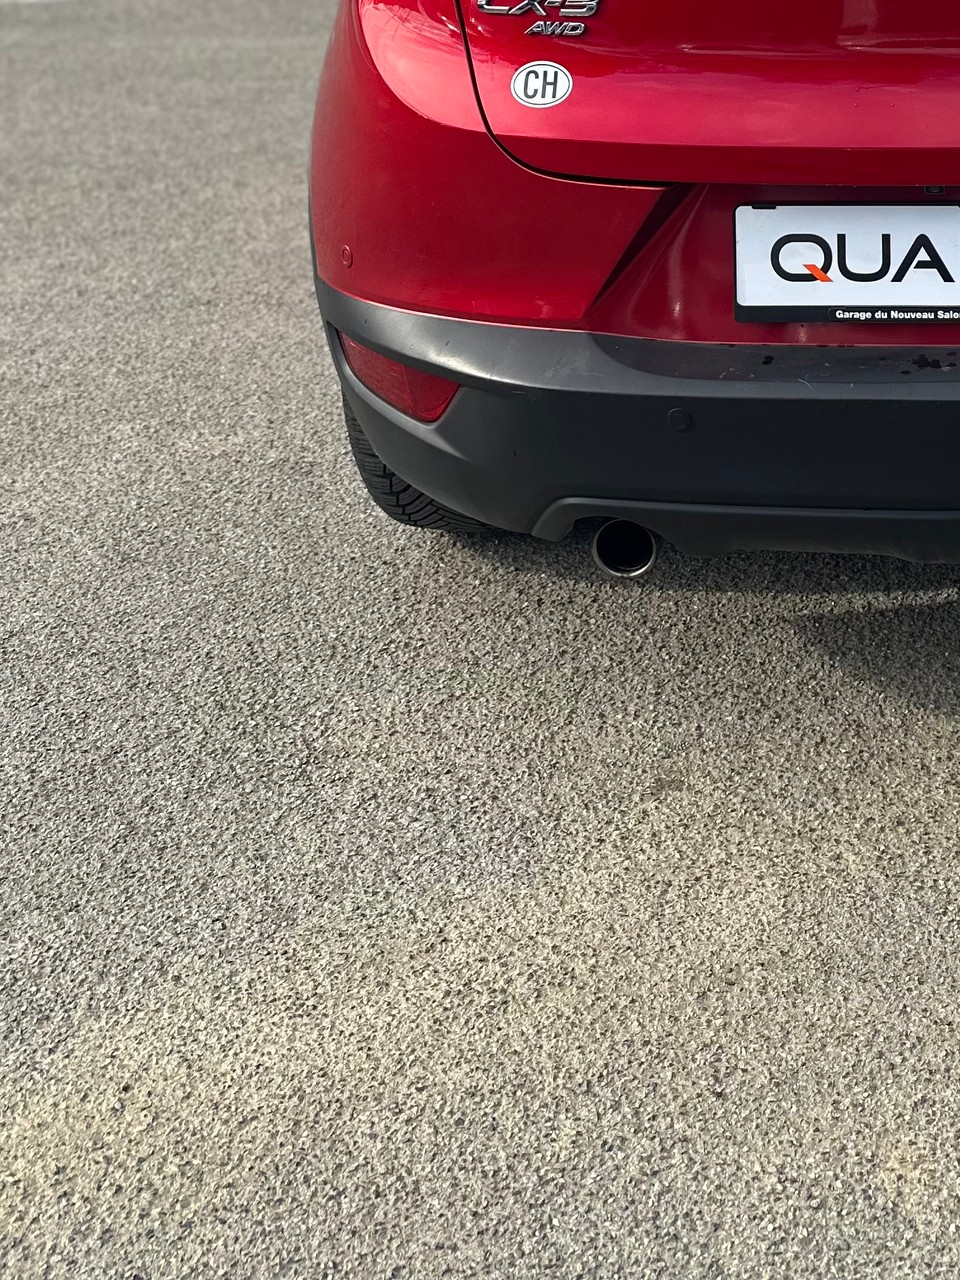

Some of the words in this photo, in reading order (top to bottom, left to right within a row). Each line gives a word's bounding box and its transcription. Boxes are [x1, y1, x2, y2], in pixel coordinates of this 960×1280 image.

[524, 20, 586, 36] AWD
[523, 69, 559, 99] CH
[835, 310, 872, 320] Garage
[874, 310, 888, 319] du
[890, 310, 935, 319] Nouveau
